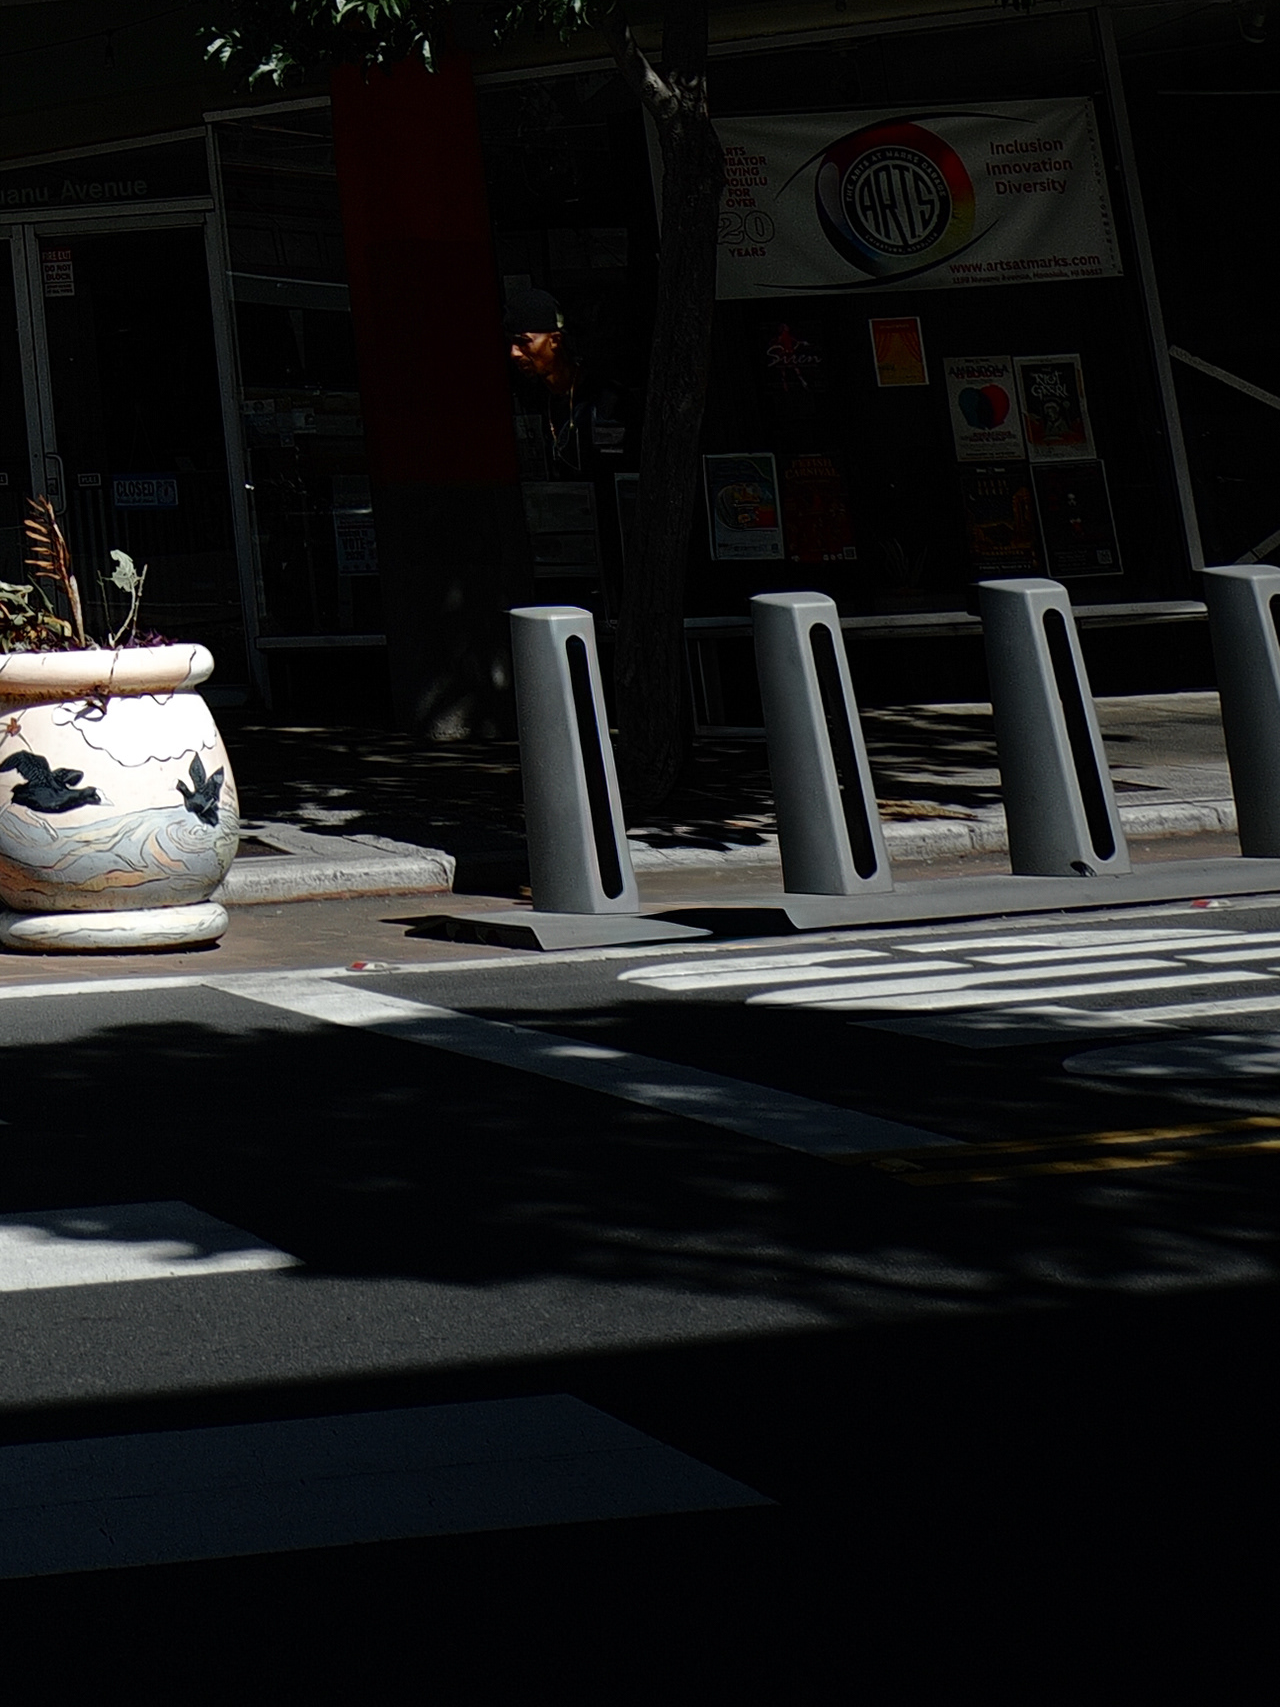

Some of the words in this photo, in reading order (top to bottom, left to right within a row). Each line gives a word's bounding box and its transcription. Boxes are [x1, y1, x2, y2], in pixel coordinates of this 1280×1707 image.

[722, 146, 746, 156] RTS
[990, 138, 1064, 155] Inclusion
[871, 151, 882, 163] AT
[986, 157, 1073, 176] Innovation
[60, 178, 148, 200] Avenue
[724, 176, 768, 187] OLULU
[995, 177, 1067, 195] Diversity
[728, 188, 751, 198] FOR
[725, 198, 757, 208] OVER
[858, 162, 936, 246] ARTS
[716, 210, 775, 245] 20
[728, 246, 767, 257] YEARS
[949, 255, 1101, 275] www.artsatmarks.com
[766, 344, 824, 368] Siren
[116, 480, 155, 497] CLOSED
